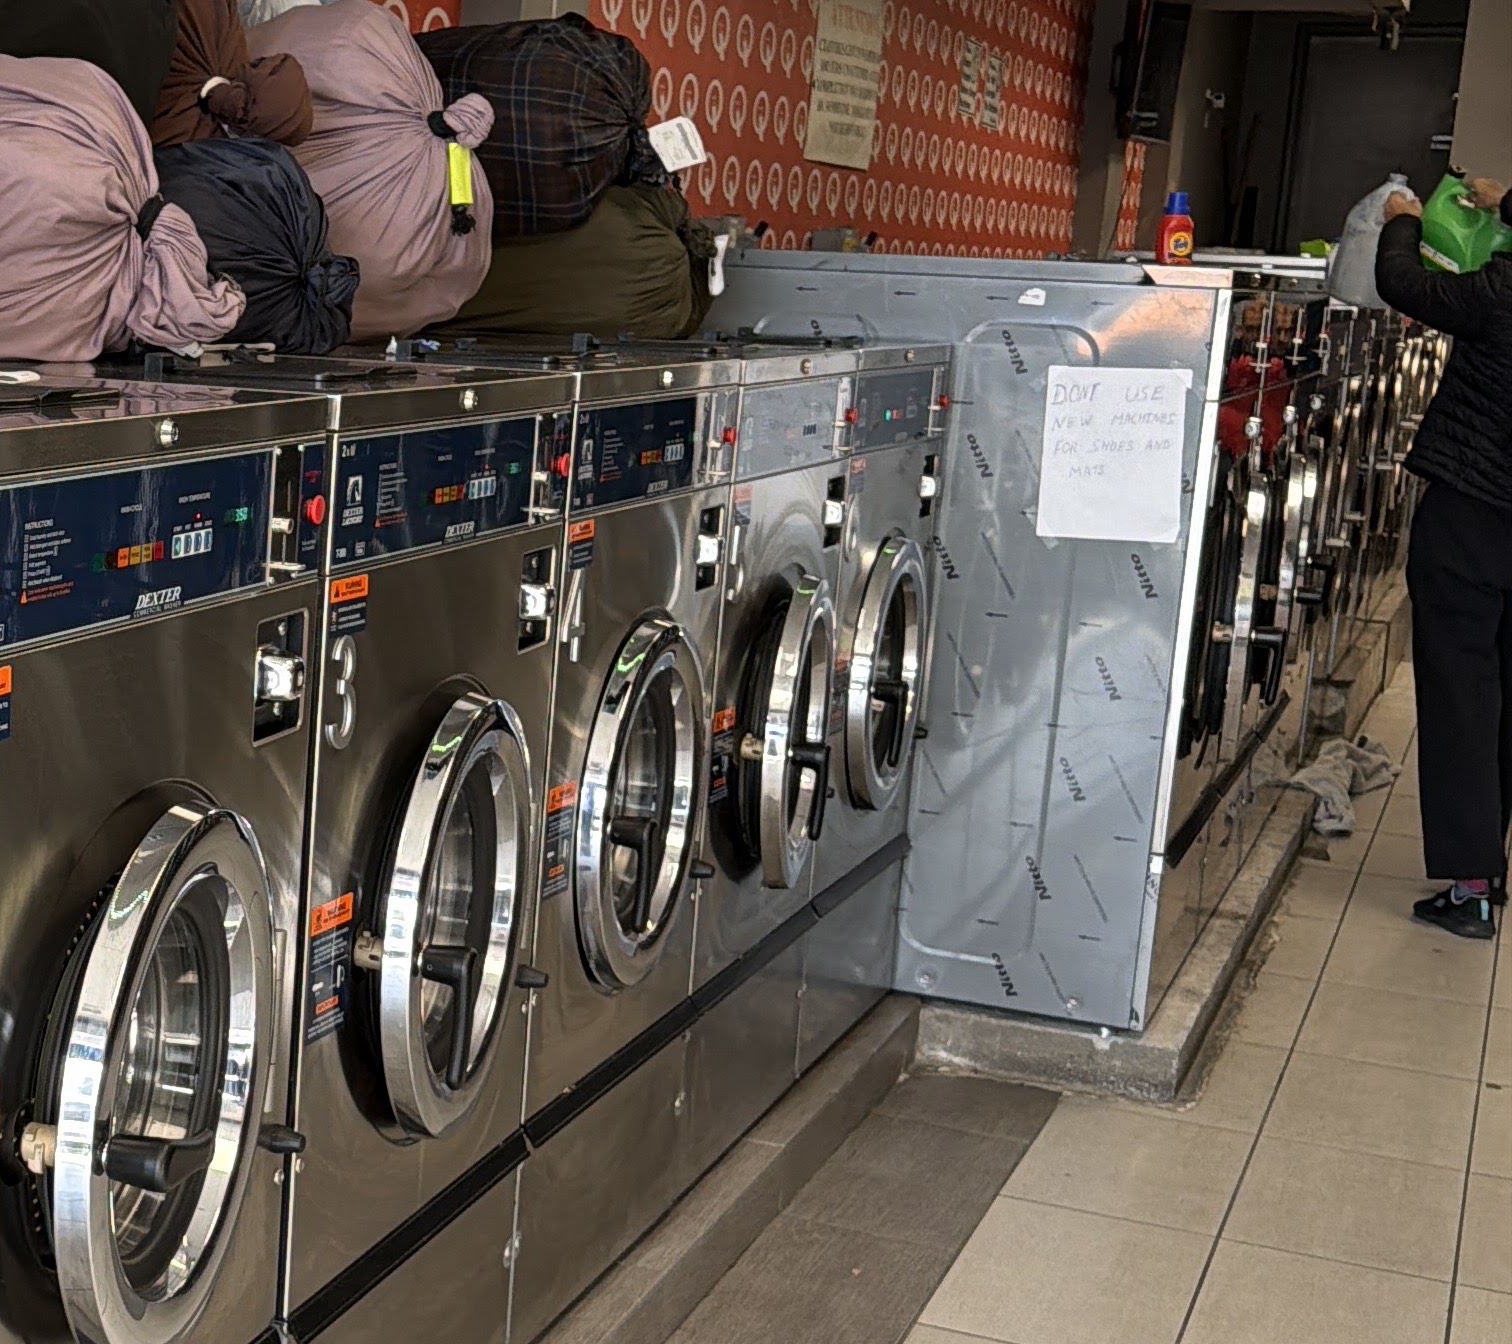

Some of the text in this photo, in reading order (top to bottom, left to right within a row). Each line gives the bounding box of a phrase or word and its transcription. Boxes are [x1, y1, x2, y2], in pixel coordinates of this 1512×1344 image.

[1002, 329, 1028, 375] Nitto
[1051, 383, 1164, 405] DONT USE
[1051, 412, 1177, 431] NEW MACHINES
[966, 433, 993, 479] Nitto
[1055, 439, 1171, 454] FOR SHOES AND
[1069, 465, 1105, 478] MATS
[933, 535, 960, 581] Nitto
[1131, 553, 1158, 599] Nitto
[136, 586, 181, 610] DEXTER
[560, 568, 585, 662] 4
[325, 634, 357, 750] 3
[1095, 656, 1122, 702] Nitto
[1060, 757, 1086, 803] Nitto
[1026, 856, 1052, 901] Nitto
[992, 953, 1017, 997] Nitto
